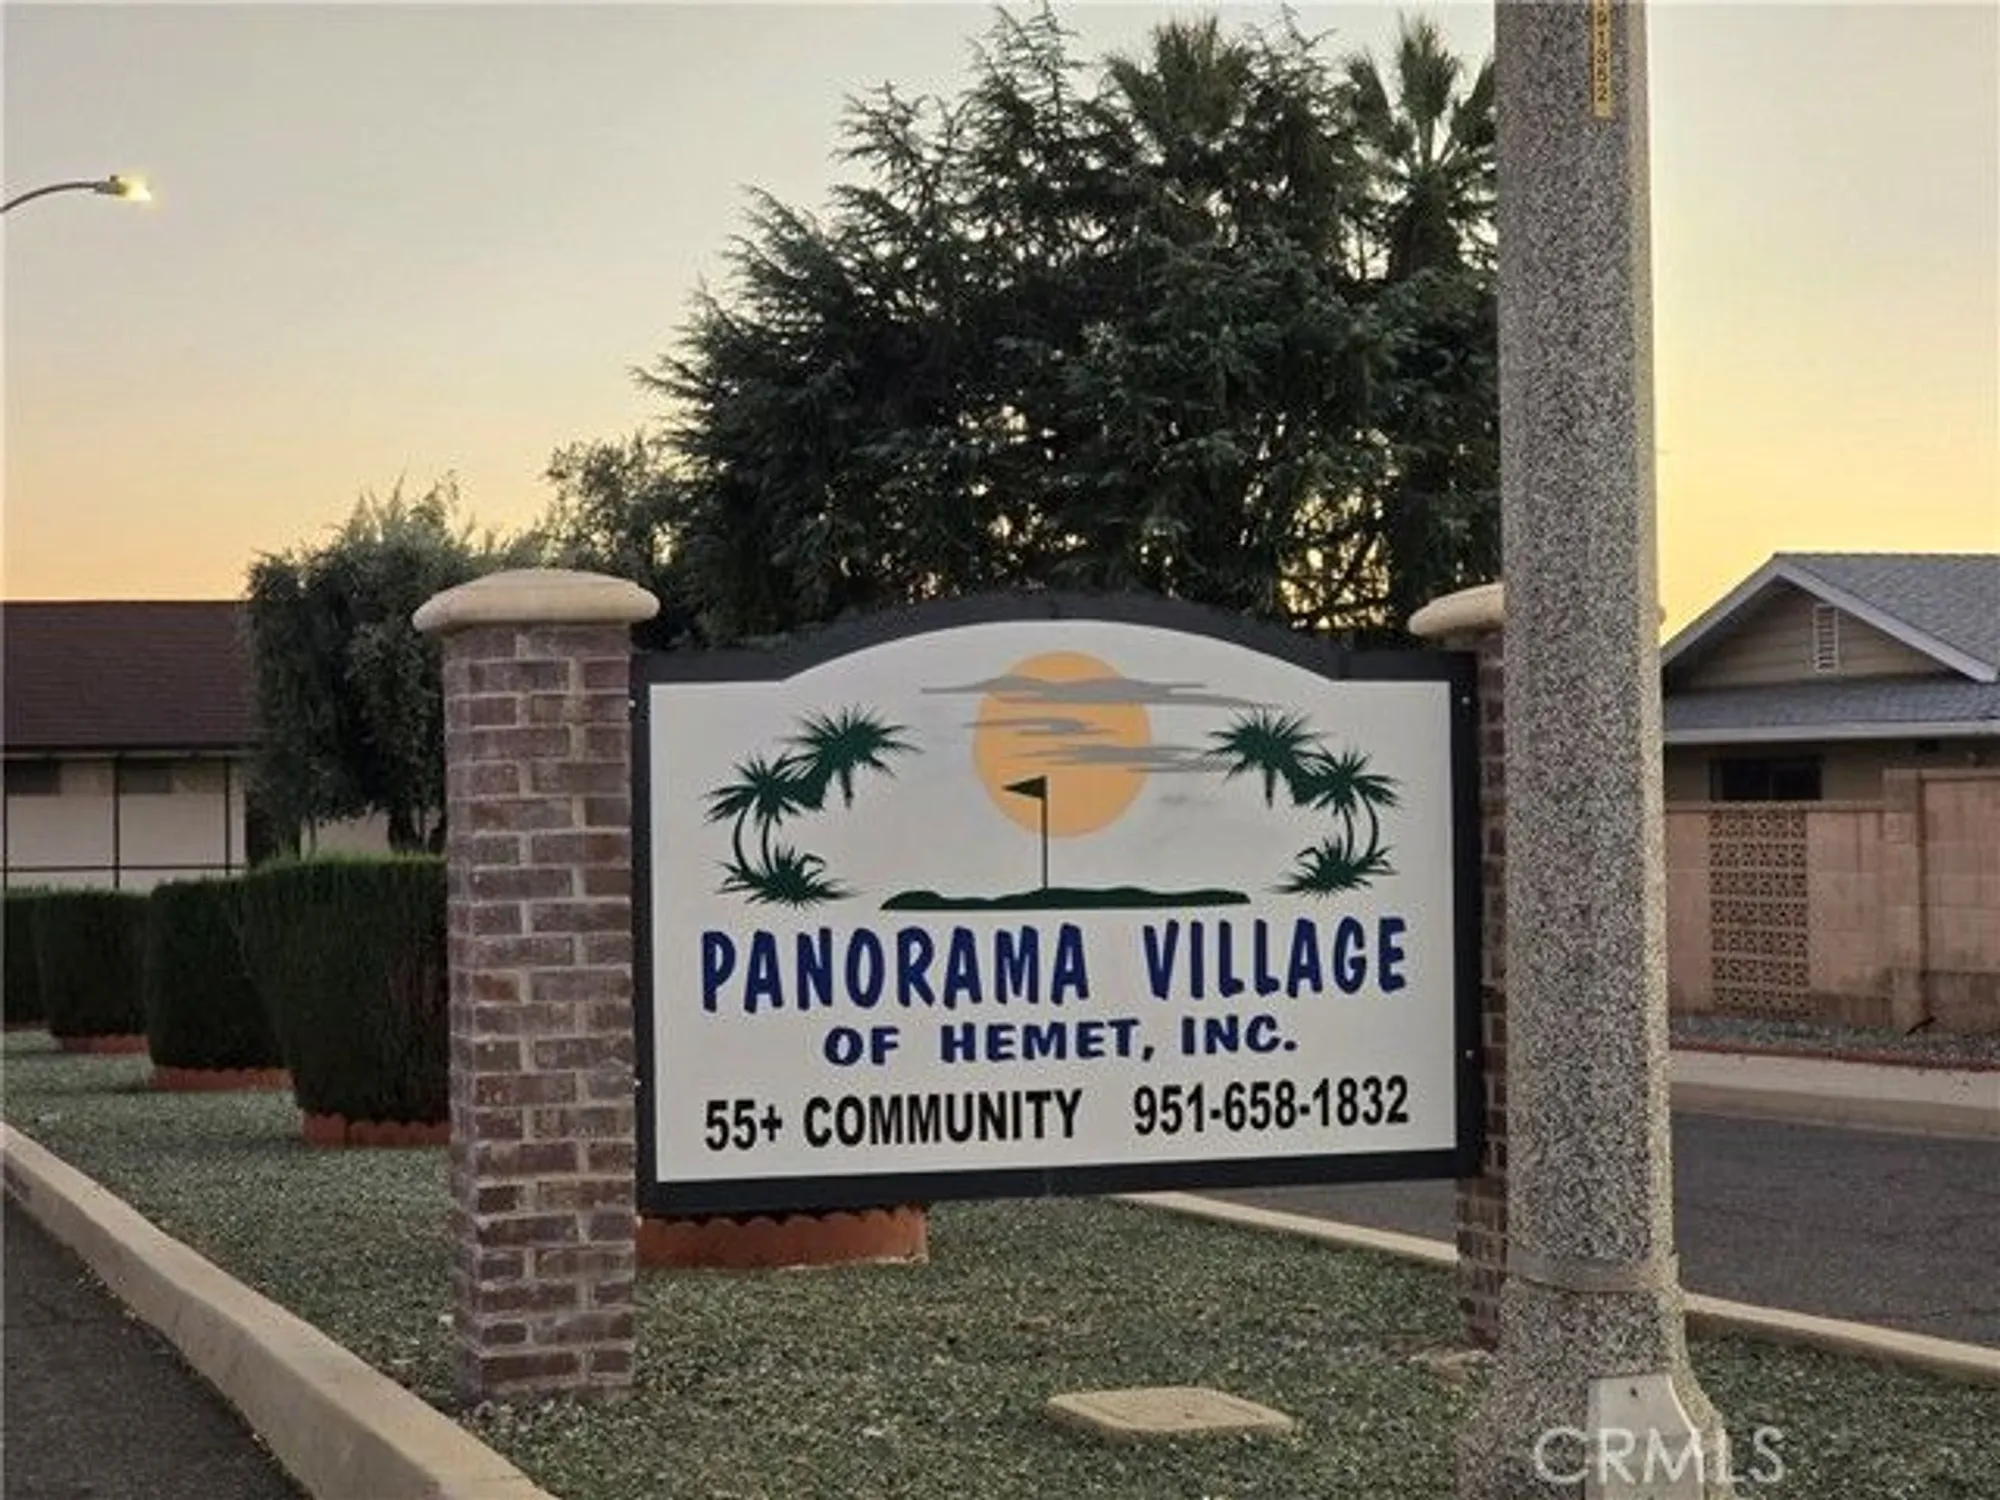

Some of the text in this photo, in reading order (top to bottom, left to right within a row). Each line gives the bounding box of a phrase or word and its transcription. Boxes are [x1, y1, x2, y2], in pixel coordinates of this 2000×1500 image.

[701, 915, 1408, 1015] PANORAMA VILLAGE
[823, 1013, 1298, 1067] OF HEMET, INC.
[704, 1074, 1410, 1152] 55+ COMMUNITY 951-658-1832
